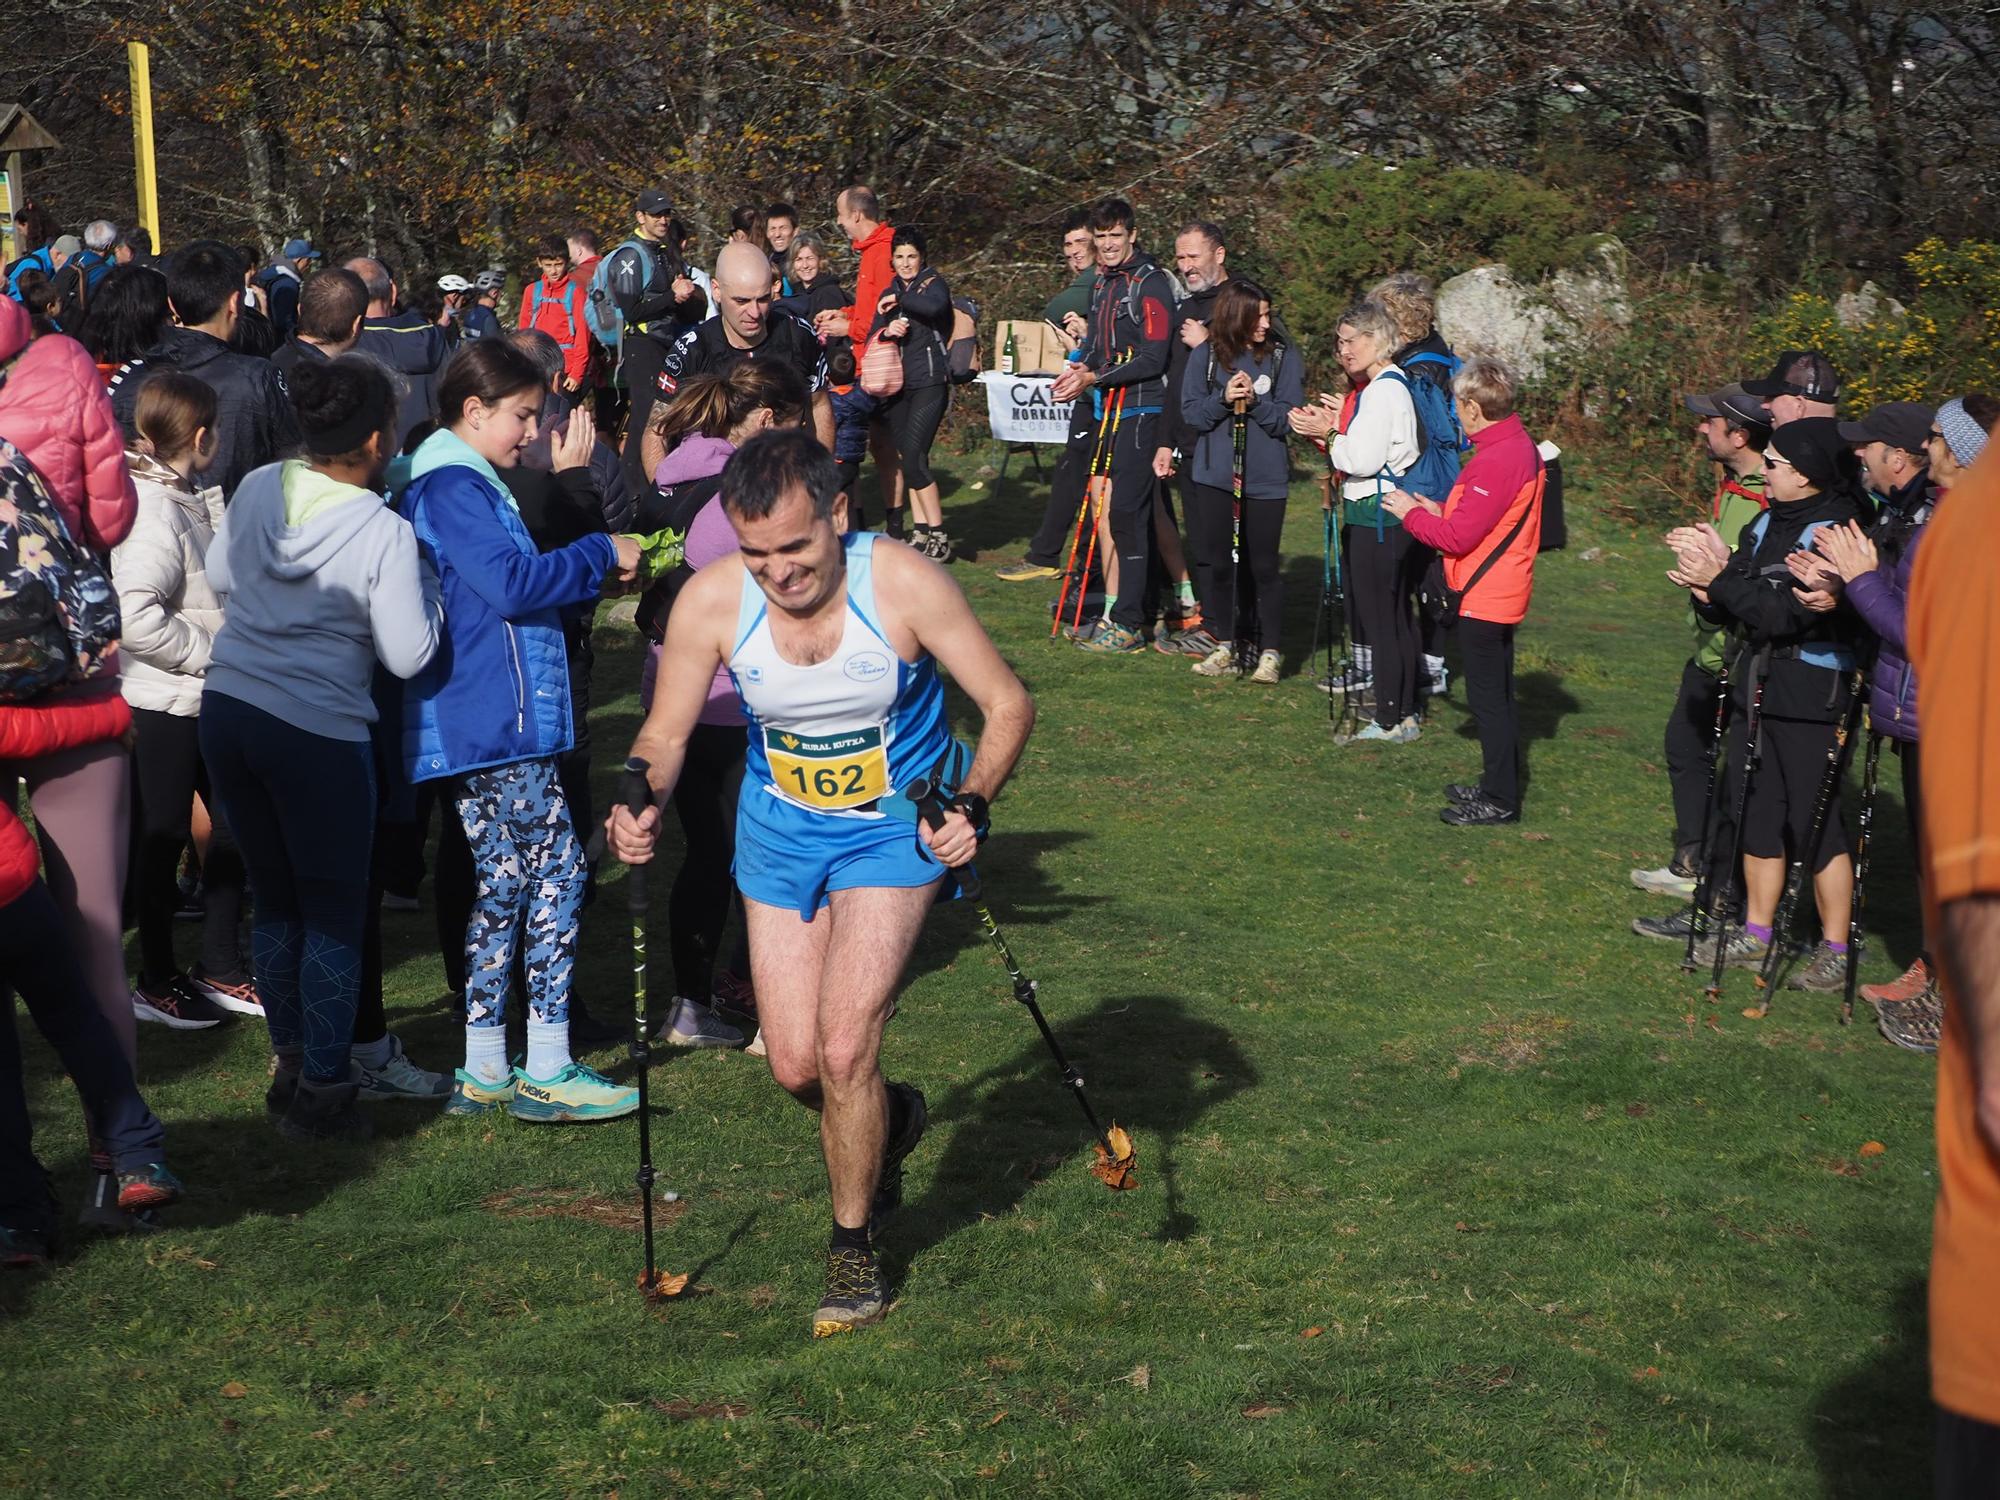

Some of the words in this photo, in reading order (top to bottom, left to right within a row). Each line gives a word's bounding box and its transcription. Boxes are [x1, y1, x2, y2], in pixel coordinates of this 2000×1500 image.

[1010, 383, 1071, 407] CAT
[801, 741, 832, 752] RURAL
[832, 736, 866, 750] KUTXA
[791, 764, 866, 798] 162
[520, 1082, 551, 1102] HOKA
